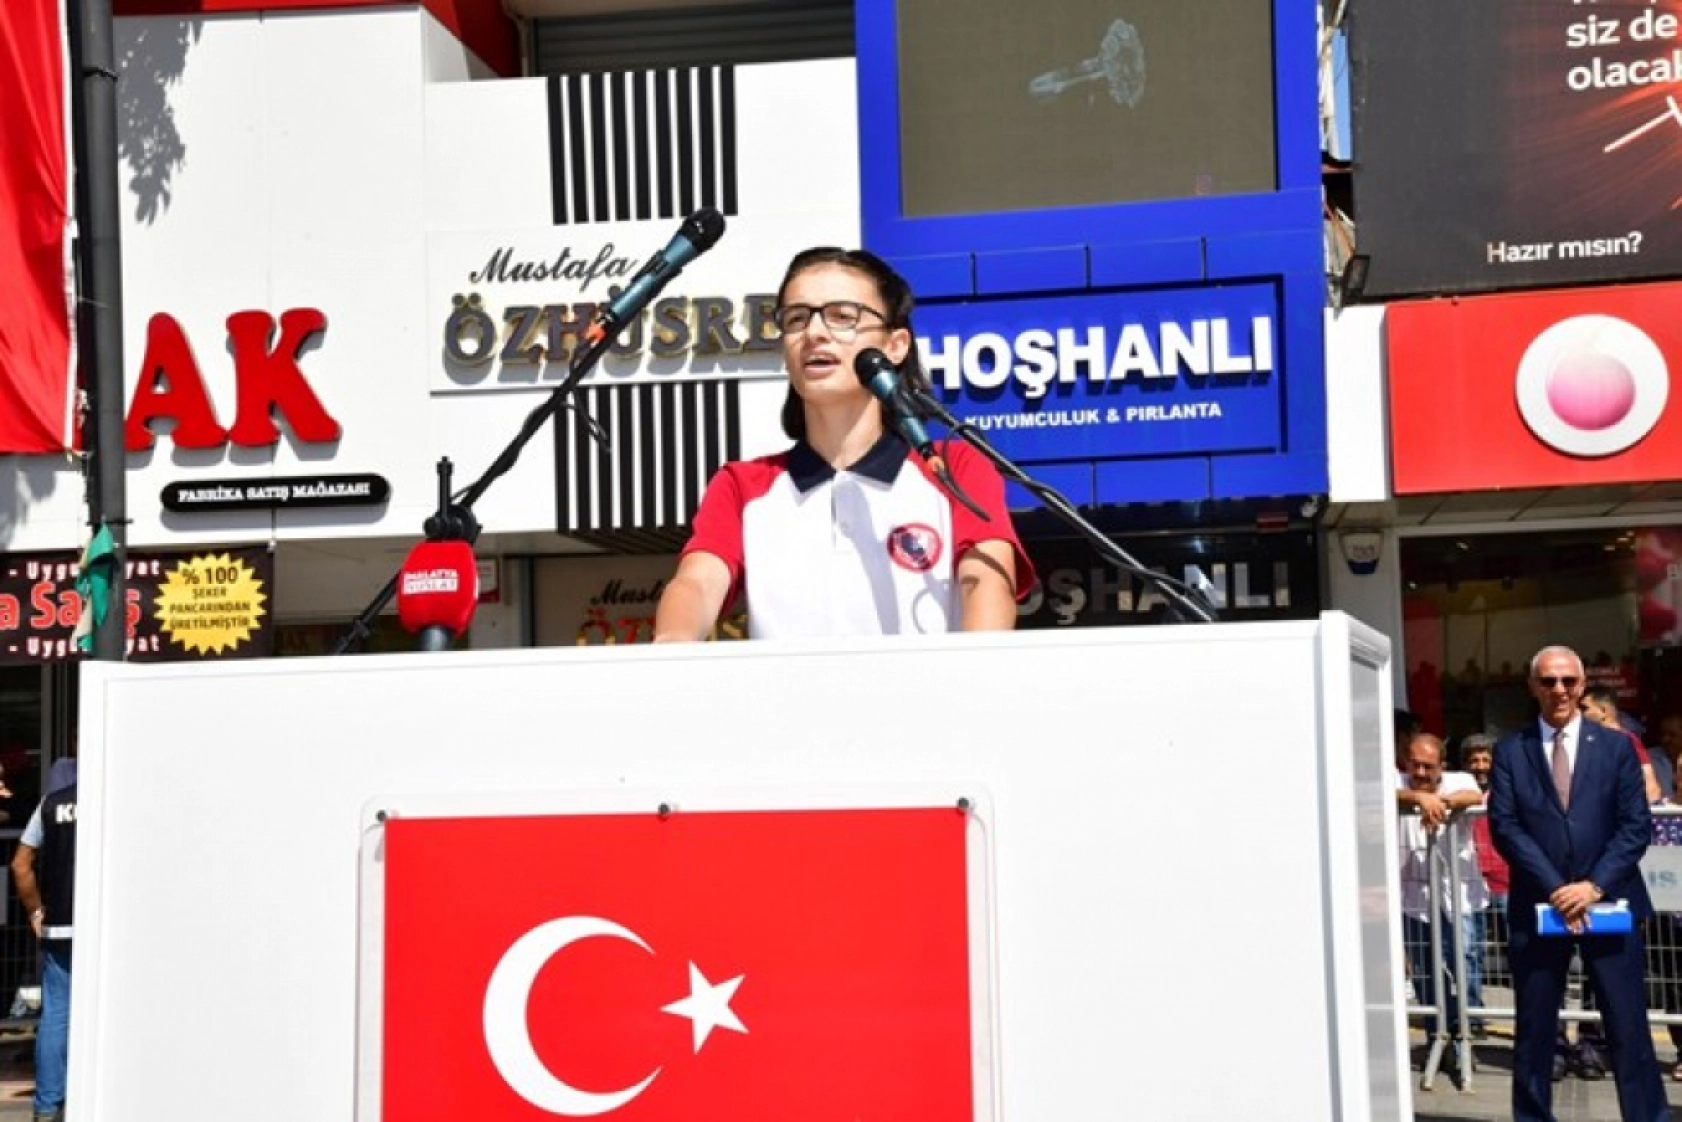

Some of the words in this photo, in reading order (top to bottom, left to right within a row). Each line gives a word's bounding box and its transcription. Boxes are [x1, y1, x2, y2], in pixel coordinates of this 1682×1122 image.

[1566, 14, 1620, 47] siz
[1628, 8, 1678, 41] de
[470, 243, 638, 291] Mustafa
[1486, 240, 1553, 264] Hazır
[1559, 231, 1642, 259] mısın?
[444, 284, 784, 364] ÖZHÜSRE
[125, 307, 342, 446] AK
[916, 316, 1273, 398] HOŞHANLI
[1106, 408, 1120, 422] &
[1126, 401, 1222, 421] PIRLANTA
[26, 561, 80, 580] Uygu
[182, 568, 200, 584] %
[205, 567, 238, 584] 100
[1016, 561, 1292, 625] OŞHANLI
